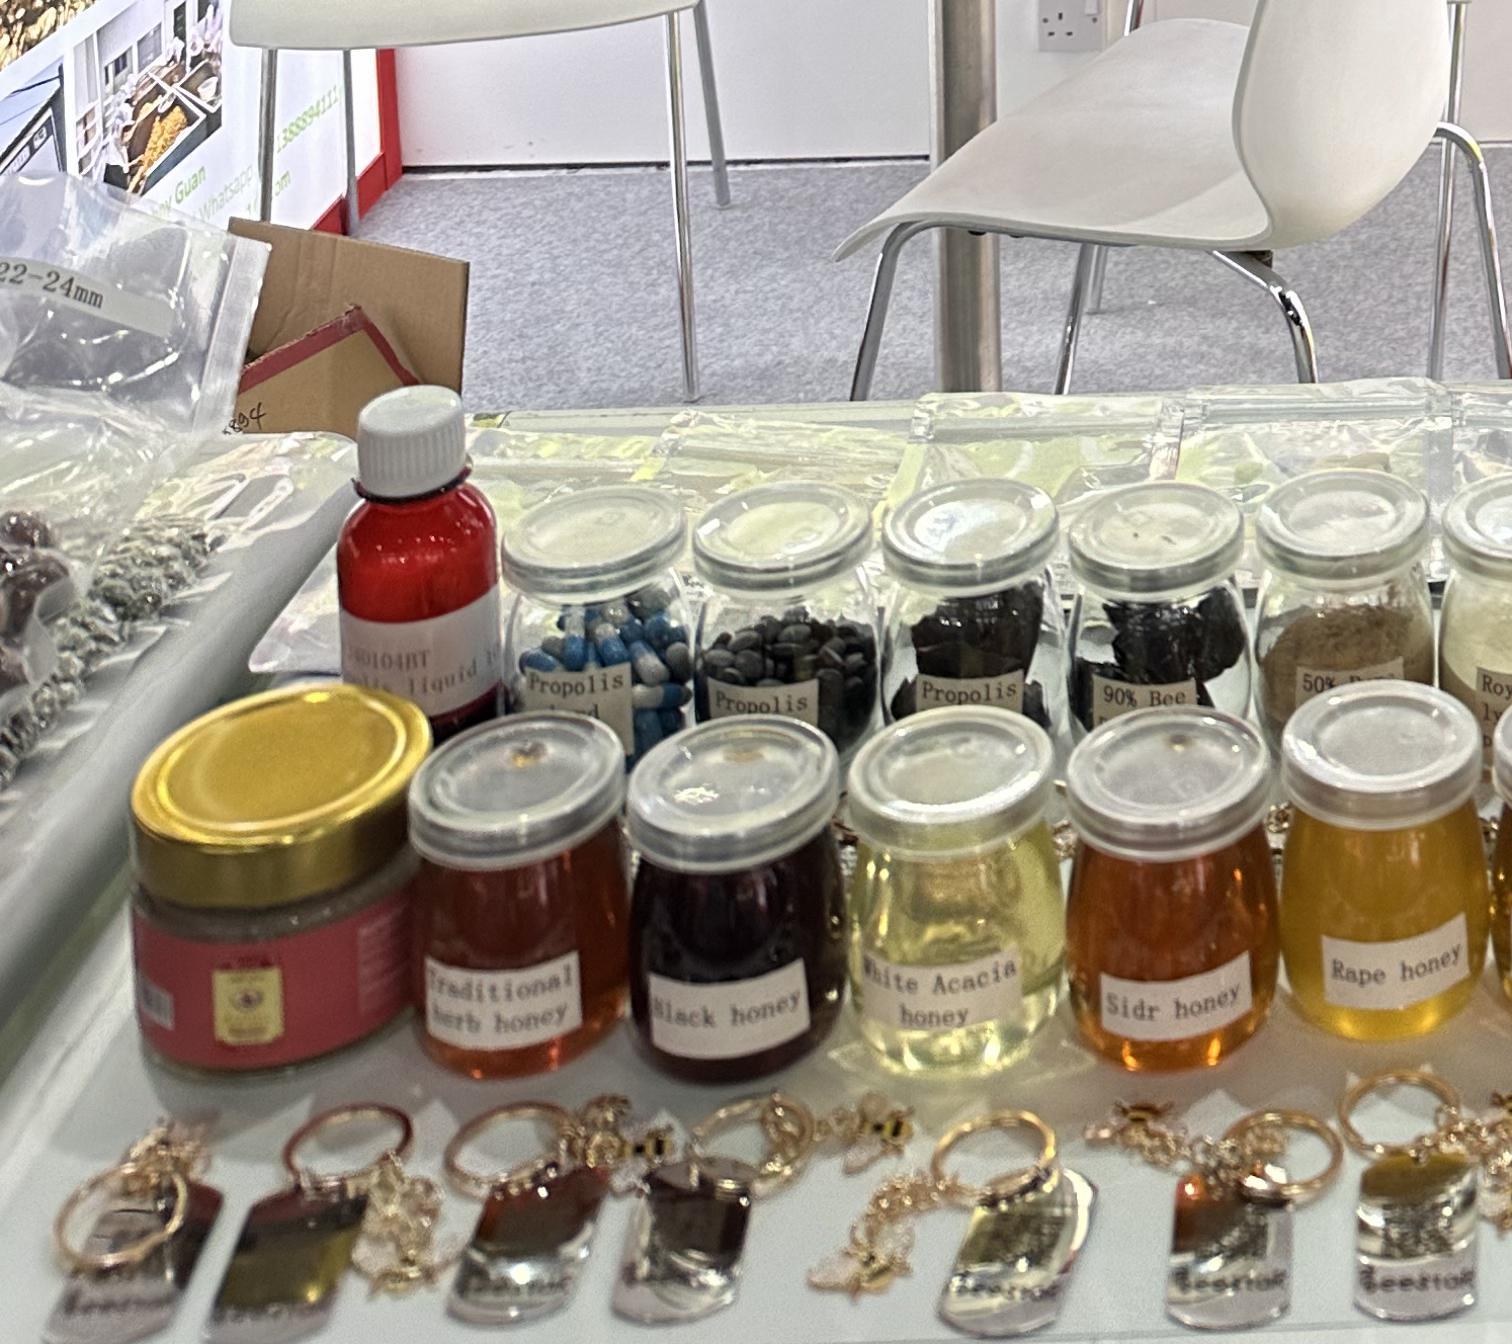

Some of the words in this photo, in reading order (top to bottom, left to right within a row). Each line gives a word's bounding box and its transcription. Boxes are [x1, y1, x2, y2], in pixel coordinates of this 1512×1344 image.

[529, 671, 625, 699] Propolis
[921, 680, 1018, 709] Propolis
[1149, 688, 1187, 708] Bee
[716, 689, 809, 714] Propolis
[931, 957, 1020, 996] Acacia
[1330, 956, 1387, 989] Rape
[1399, 941, 1464, 983] honey
[494, 998, 569, 1033] honey
[729, 986, 804, 1029] honey
[901, 1000, 969, 1030] honey
[1105, 991, 1161, 1024] Sidr
[1173, 984, 1241, 1024] honey
